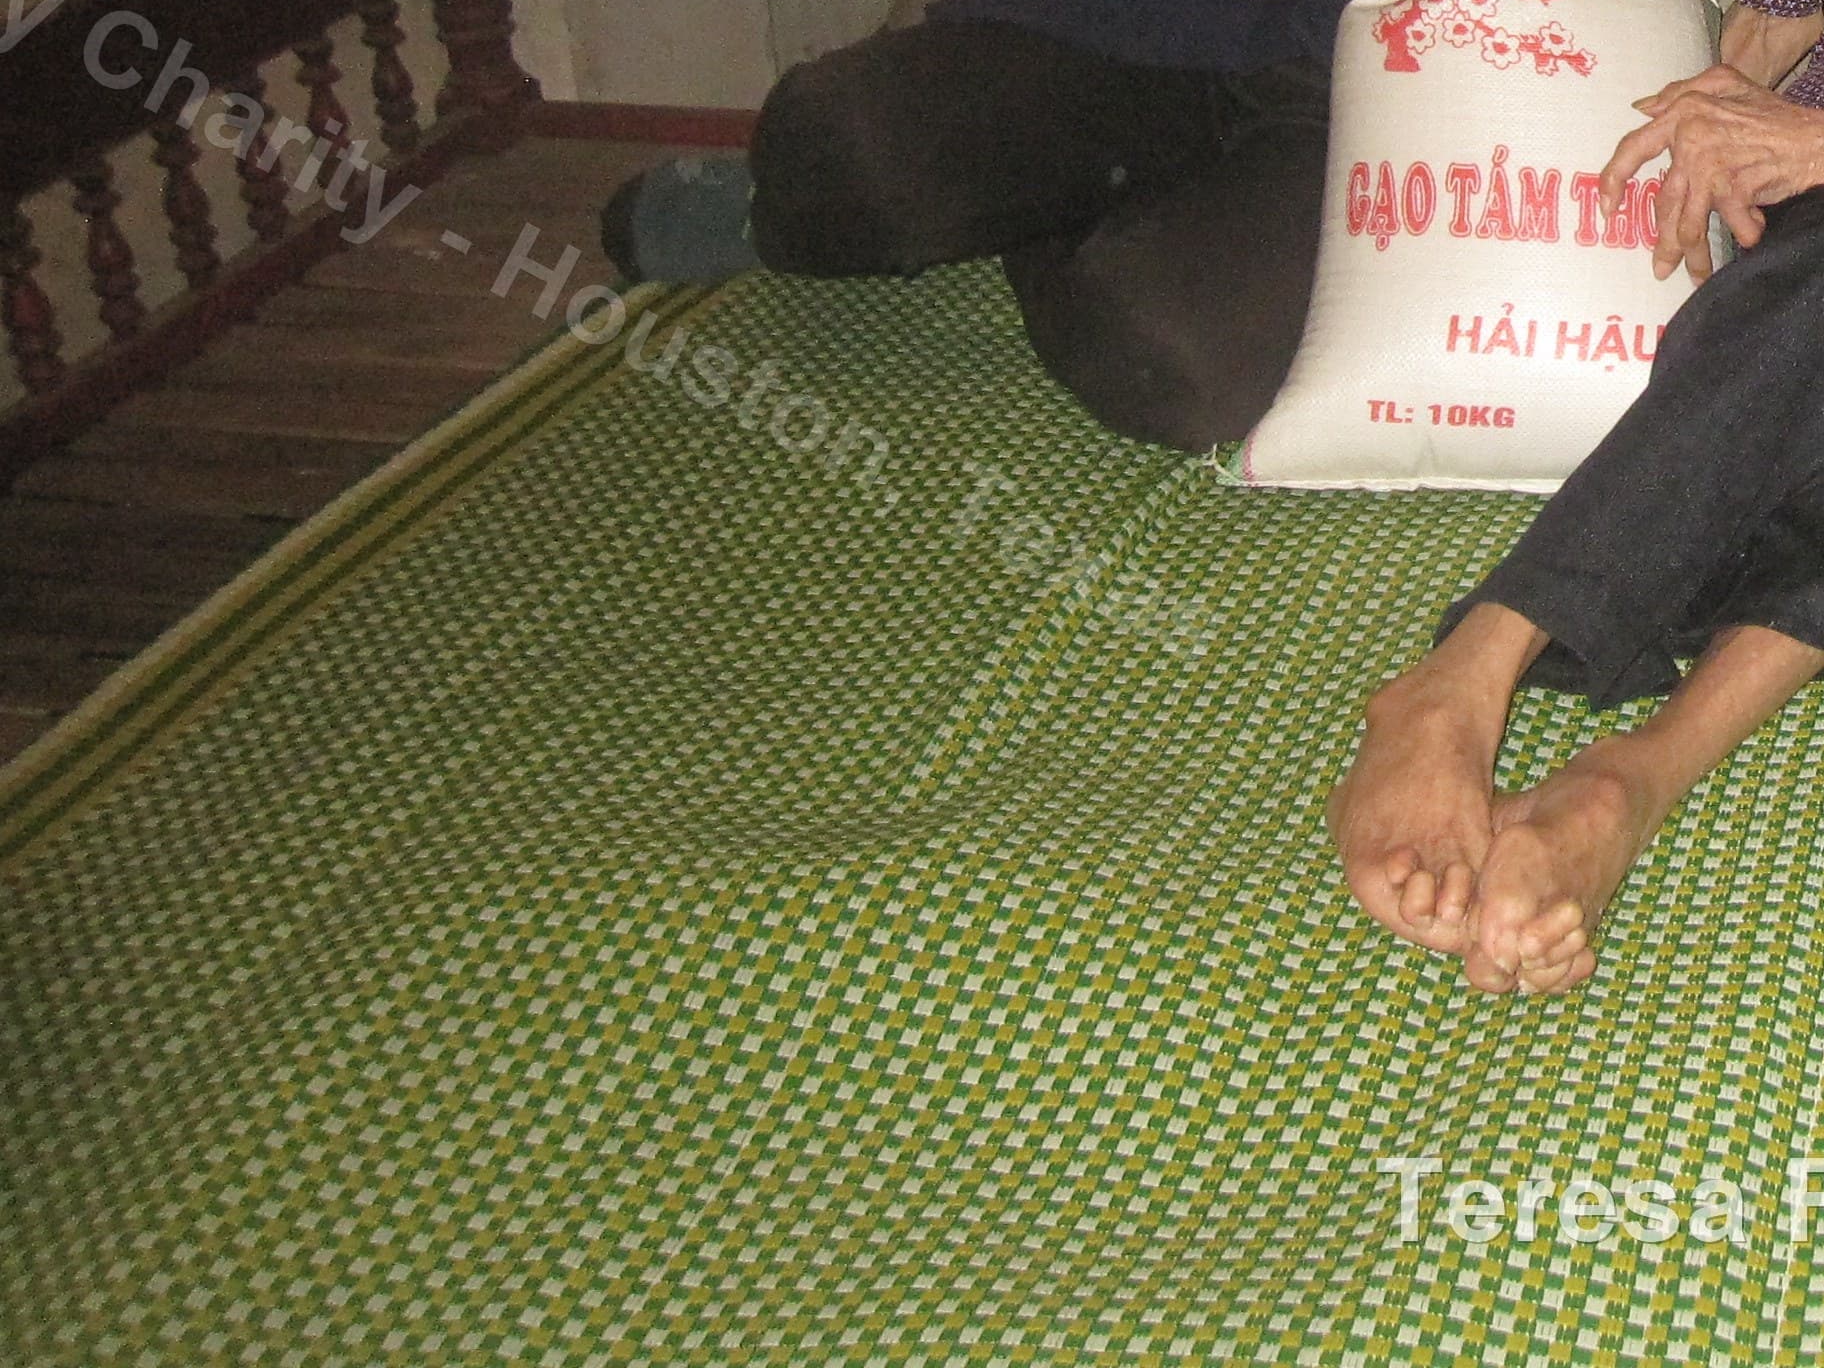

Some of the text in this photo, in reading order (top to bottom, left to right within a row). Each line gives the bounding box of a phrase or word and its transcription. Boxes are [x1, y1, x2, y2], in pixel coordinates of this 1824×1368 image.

[1345, 160, 1437, 252] GẠO
[1446, 302, 1667, 373] HẢI HẬU
[1367, 399, 1517, 429] TL: 10KG
